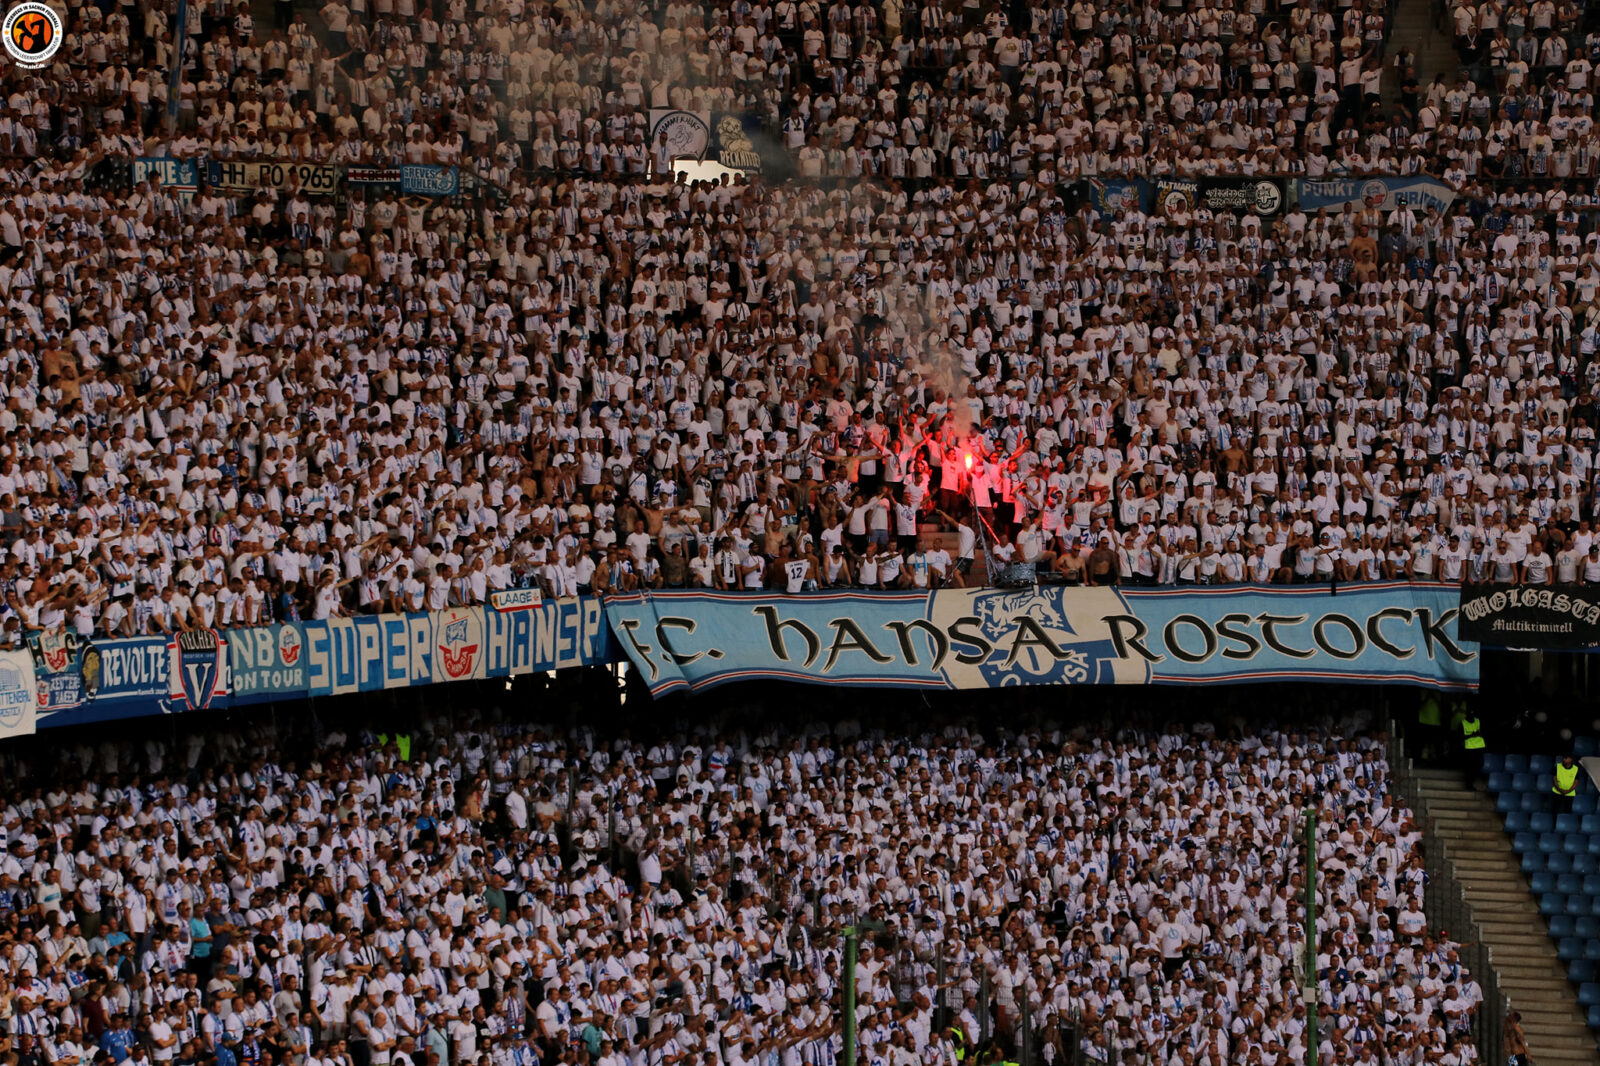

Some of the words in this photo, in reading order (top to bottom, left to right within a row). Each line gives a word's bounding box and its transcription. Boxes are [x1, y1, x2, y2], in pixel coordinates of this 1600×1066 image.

[219, 162, 245, 185] HH
[1157, 180, 1198, 192] ALTMARK
[1302, 182, 1355, 197] PUNKT
[791, 567, 802, 580] 12
[499, 591, 532, 606] LAAGE
[1100, 607, 1478, 665] ROSTOCK
[1491, 619, 1573, 633] Multikriminell
[228, 627, 275, 670] NB
[305, 617, 432, 690] SUPER
[101, 645, 167, 688] REVOLTE
[185, 662, 213, 707] V
[234, 671, 257, 691] ON
[261, 668, 303, 688] TOUR
